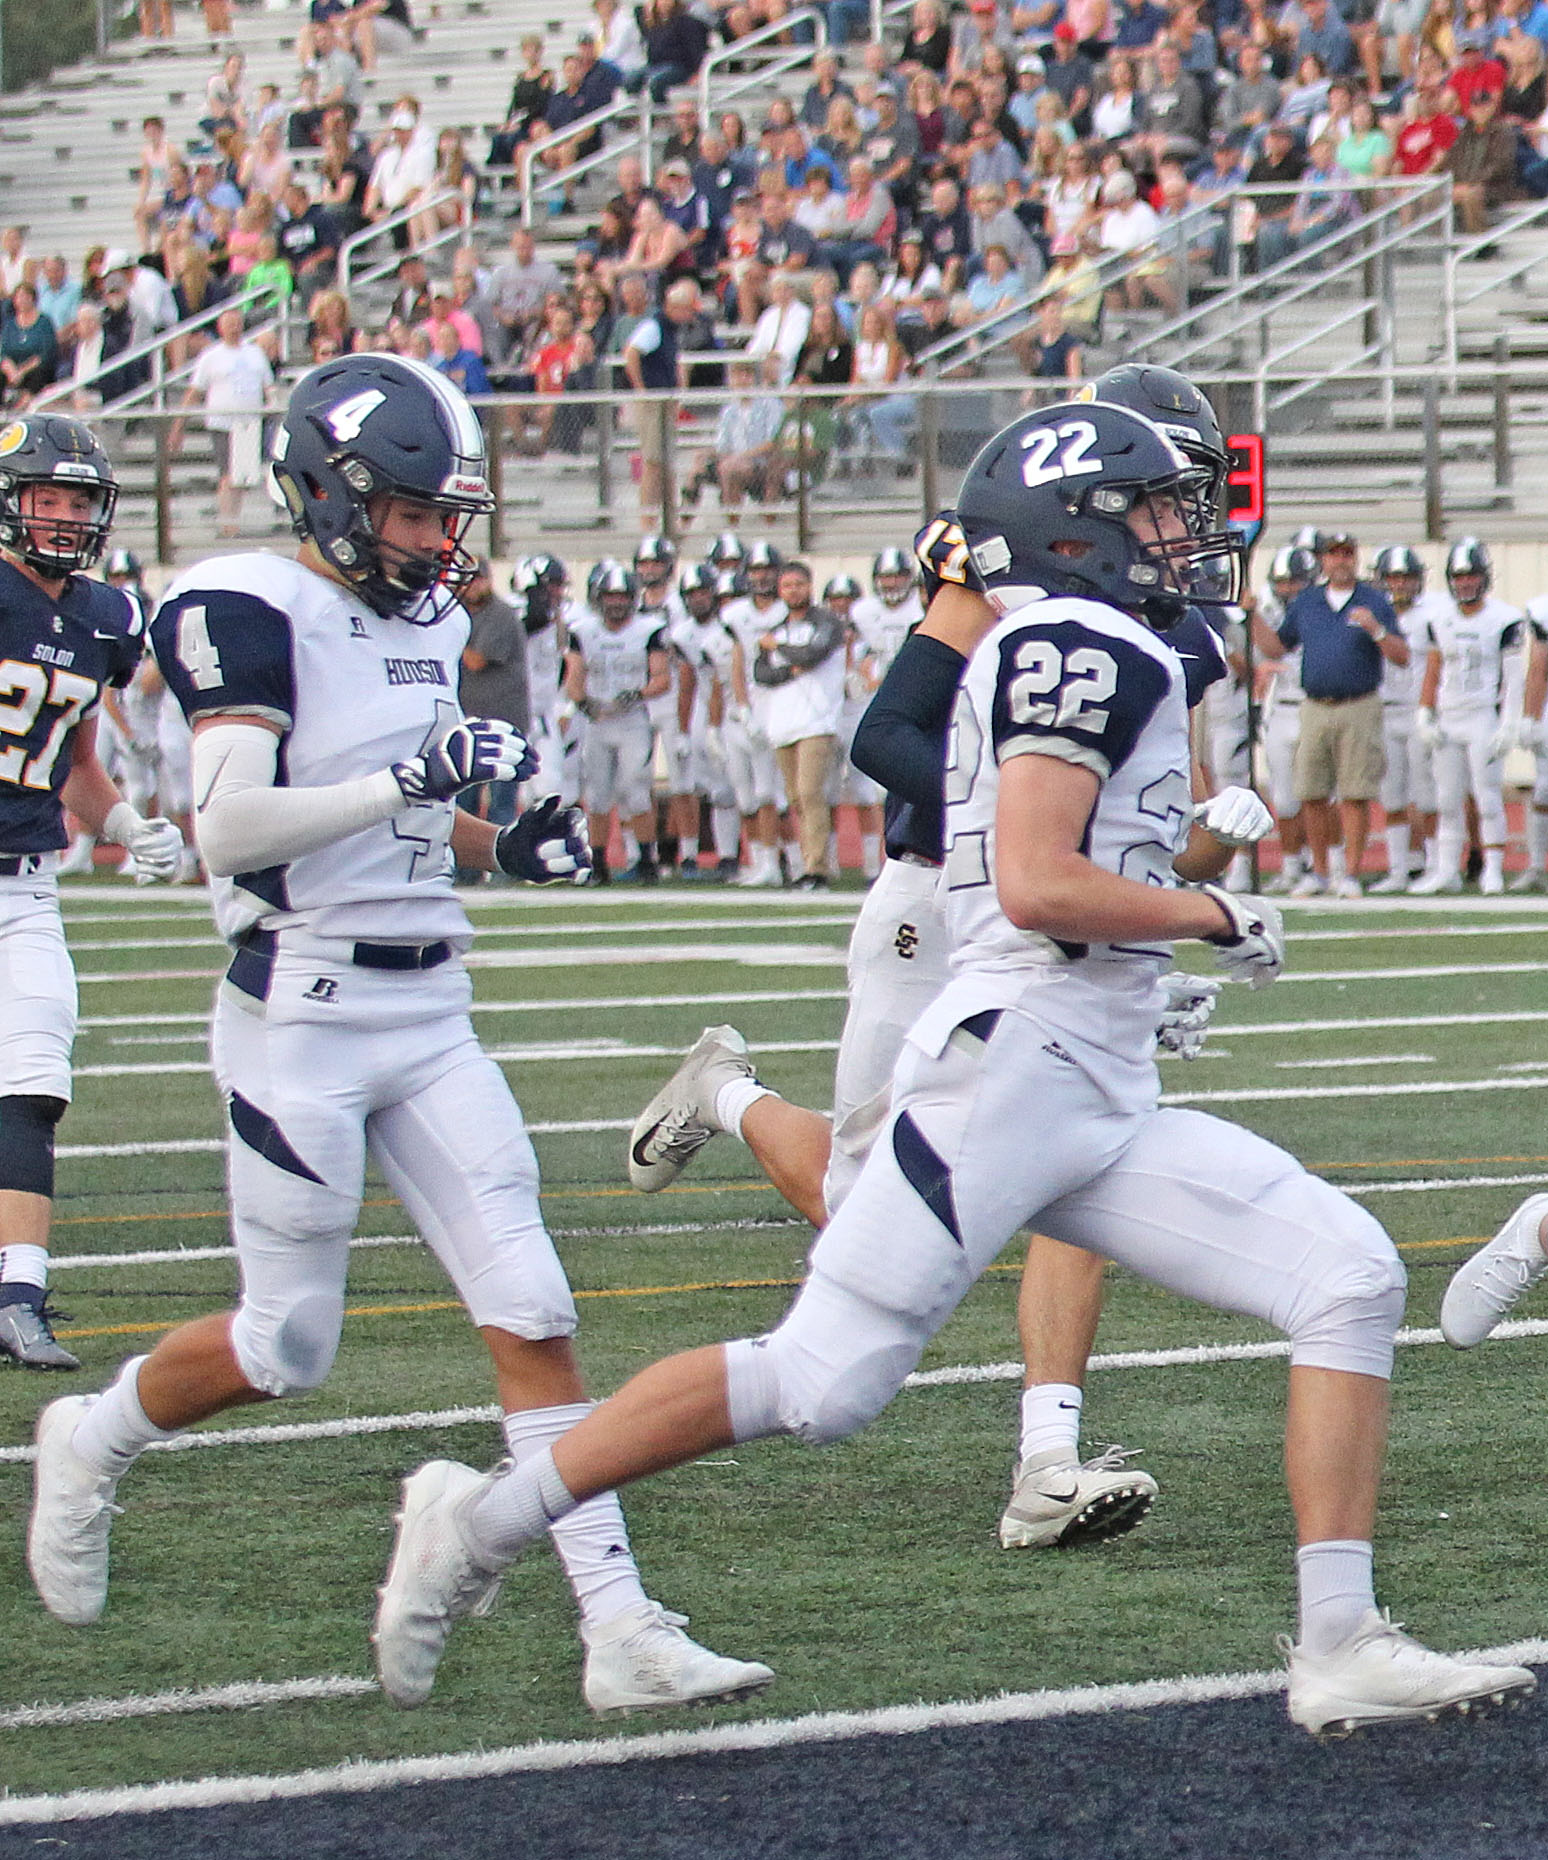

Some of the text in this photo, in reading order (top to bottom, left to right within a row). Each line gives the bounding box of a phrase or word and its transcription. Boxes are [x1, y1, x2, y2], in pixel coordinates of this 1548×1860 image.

[327, 388, 389, 443] 4
[1020, 420, 1105, 489] 22
[32, 642, 76, 668] SOLON
[174, 604, 226, 691] 4
[0, 659, 99, 791] 27
[1010, 639, 1120, 735] 22
